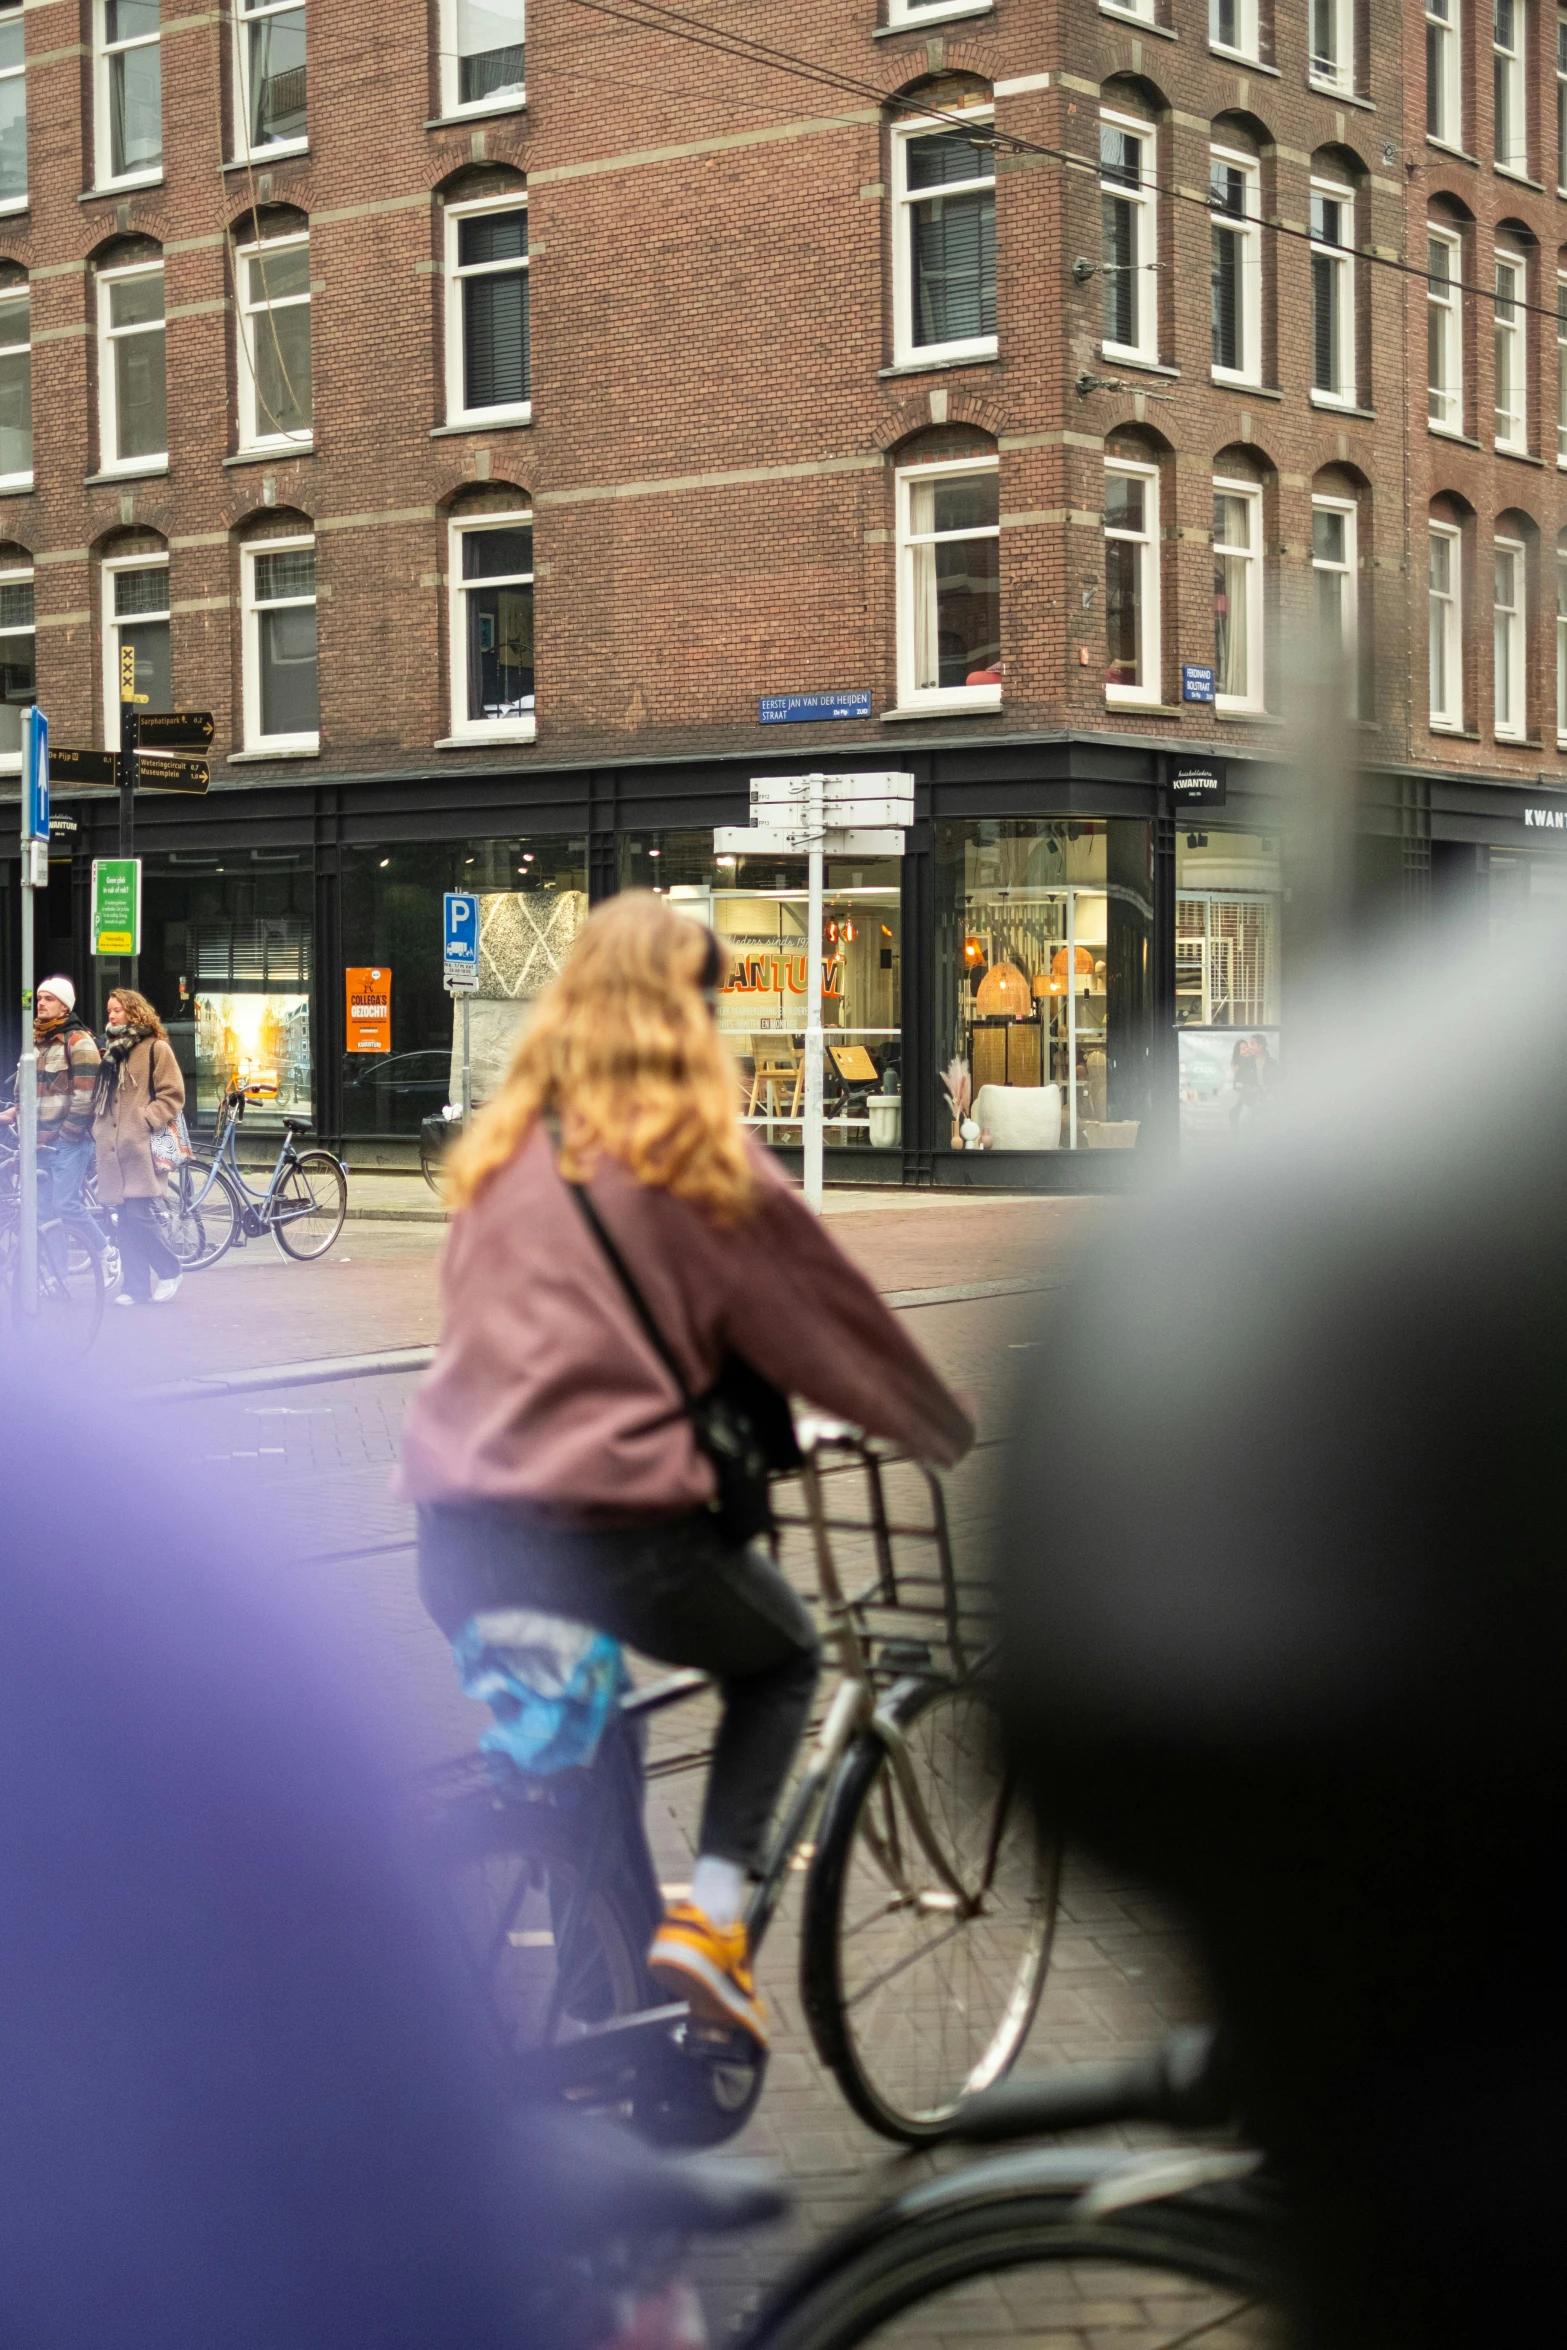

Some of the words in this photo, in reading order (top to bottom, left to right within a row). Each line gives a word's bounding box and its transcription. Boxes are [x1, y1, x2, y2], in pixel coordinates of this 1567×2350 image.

[1186, 668, 1211, 680] FERDINAND
[762, 700, 786, 710] EERSTE
[788, 699, 801, 710] JAN
[803, 698, 818, 707] VAN
[820, 697, 835, 706] DER
[837, 694, 868, 707] HEIJDEN
[762, 710, 788, 721] STRAAT
[140, 717, 180, 727] Sarphatipark
[58, 752, 71, 762] Pijp
[140, 759, 187, 770] Weteringcircuit
[140, 768, 180, 779] Museumplein
[1173, 778, 1218, 790] KWANTUM
[48, 821, 78, 832] WANTUM
[451, 900, 470, 933] P
[765, 936, 795, 947] sinds
[796, 937, 810, 948] 197
[716, 953, 845, 998] ANTUM
[351, 995, 387, 1006] COLLEGA'S
[351, 1005, 387, 1018] GEZOCHT!
[761, 1019, 770, 1029] EN
